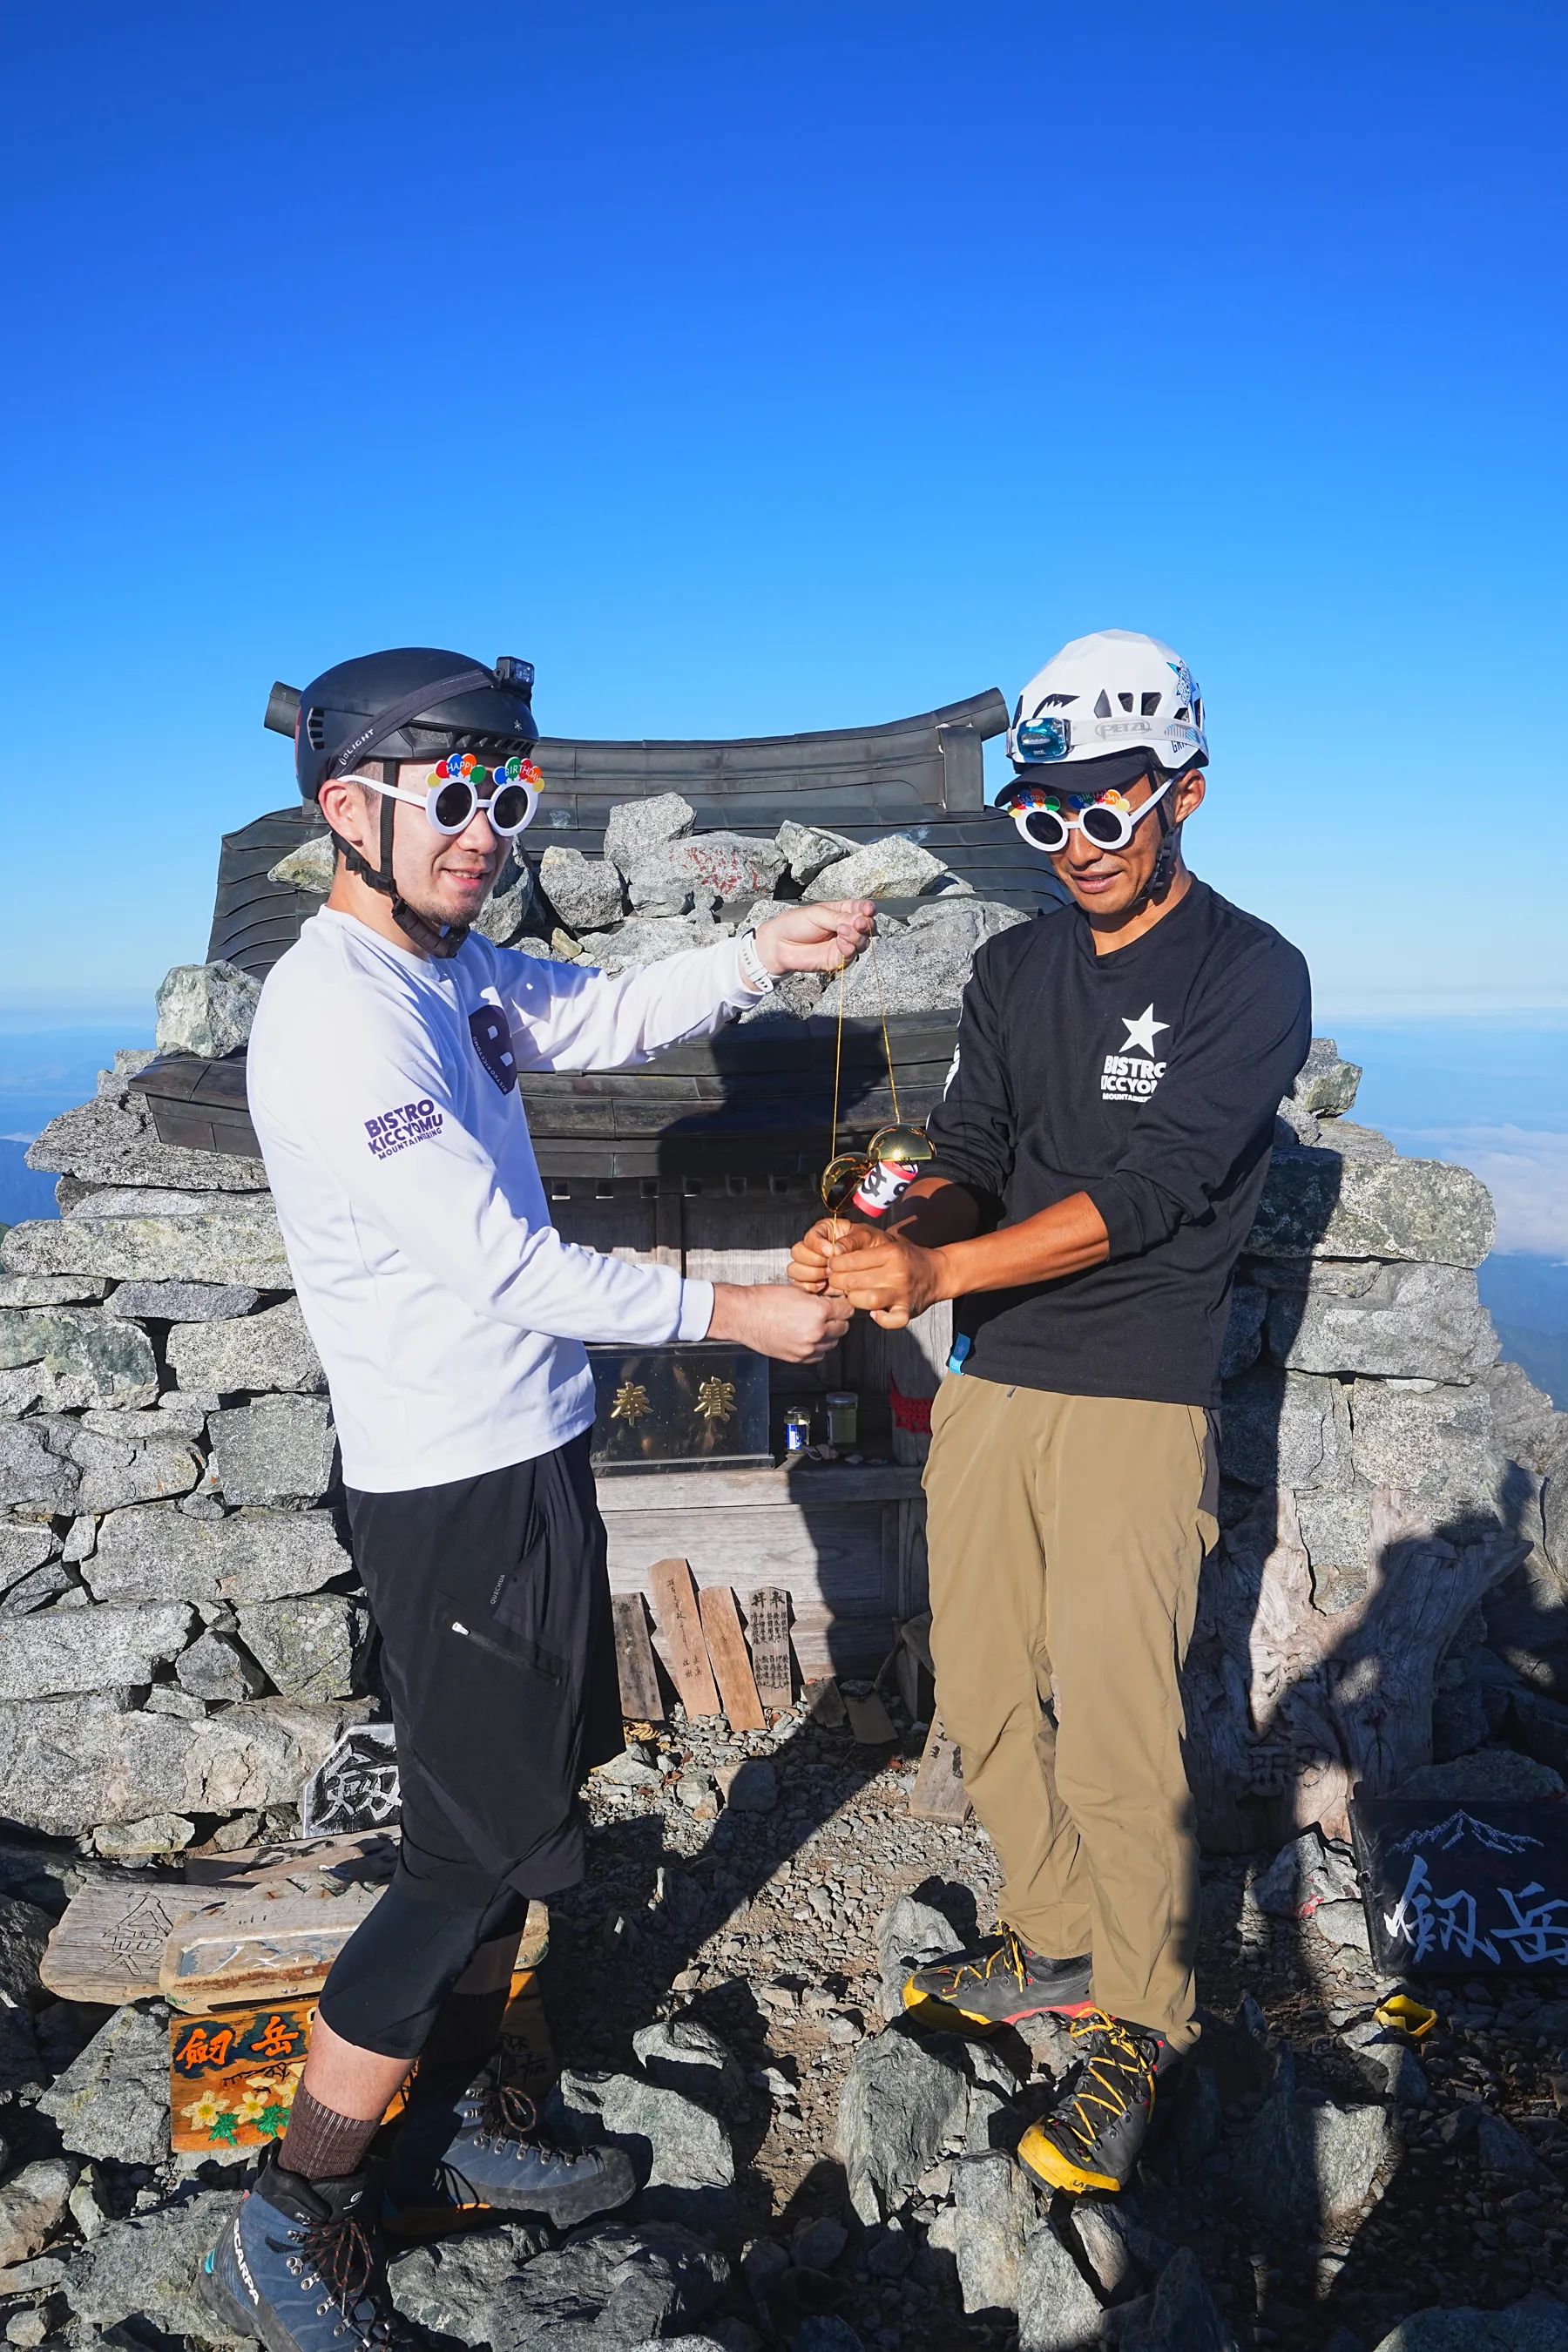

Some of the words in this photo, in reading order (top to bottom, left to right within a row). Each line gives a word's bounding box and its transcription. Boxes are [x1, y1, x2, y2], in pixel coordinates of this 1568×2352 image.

[1100, 722, 1152, 740] PETZL
[445, 760, 474, 774] HAPPY
[504, 760, 539, 781] BIRTHDAY
[1019, 794, 1045, 805] HAPPY
[1078, 791, 1120, 803] BIRTHDAY
[472, 1036, 491, 1071] KICCYOMU
[364, 1099, 435, 1139] BISTRO
[368, 1113, 443, 1155] KICCYOMU
[490, 1574, 505, 1605] QUECHUA
[233, 2217, 260, 2306] SCARPA
